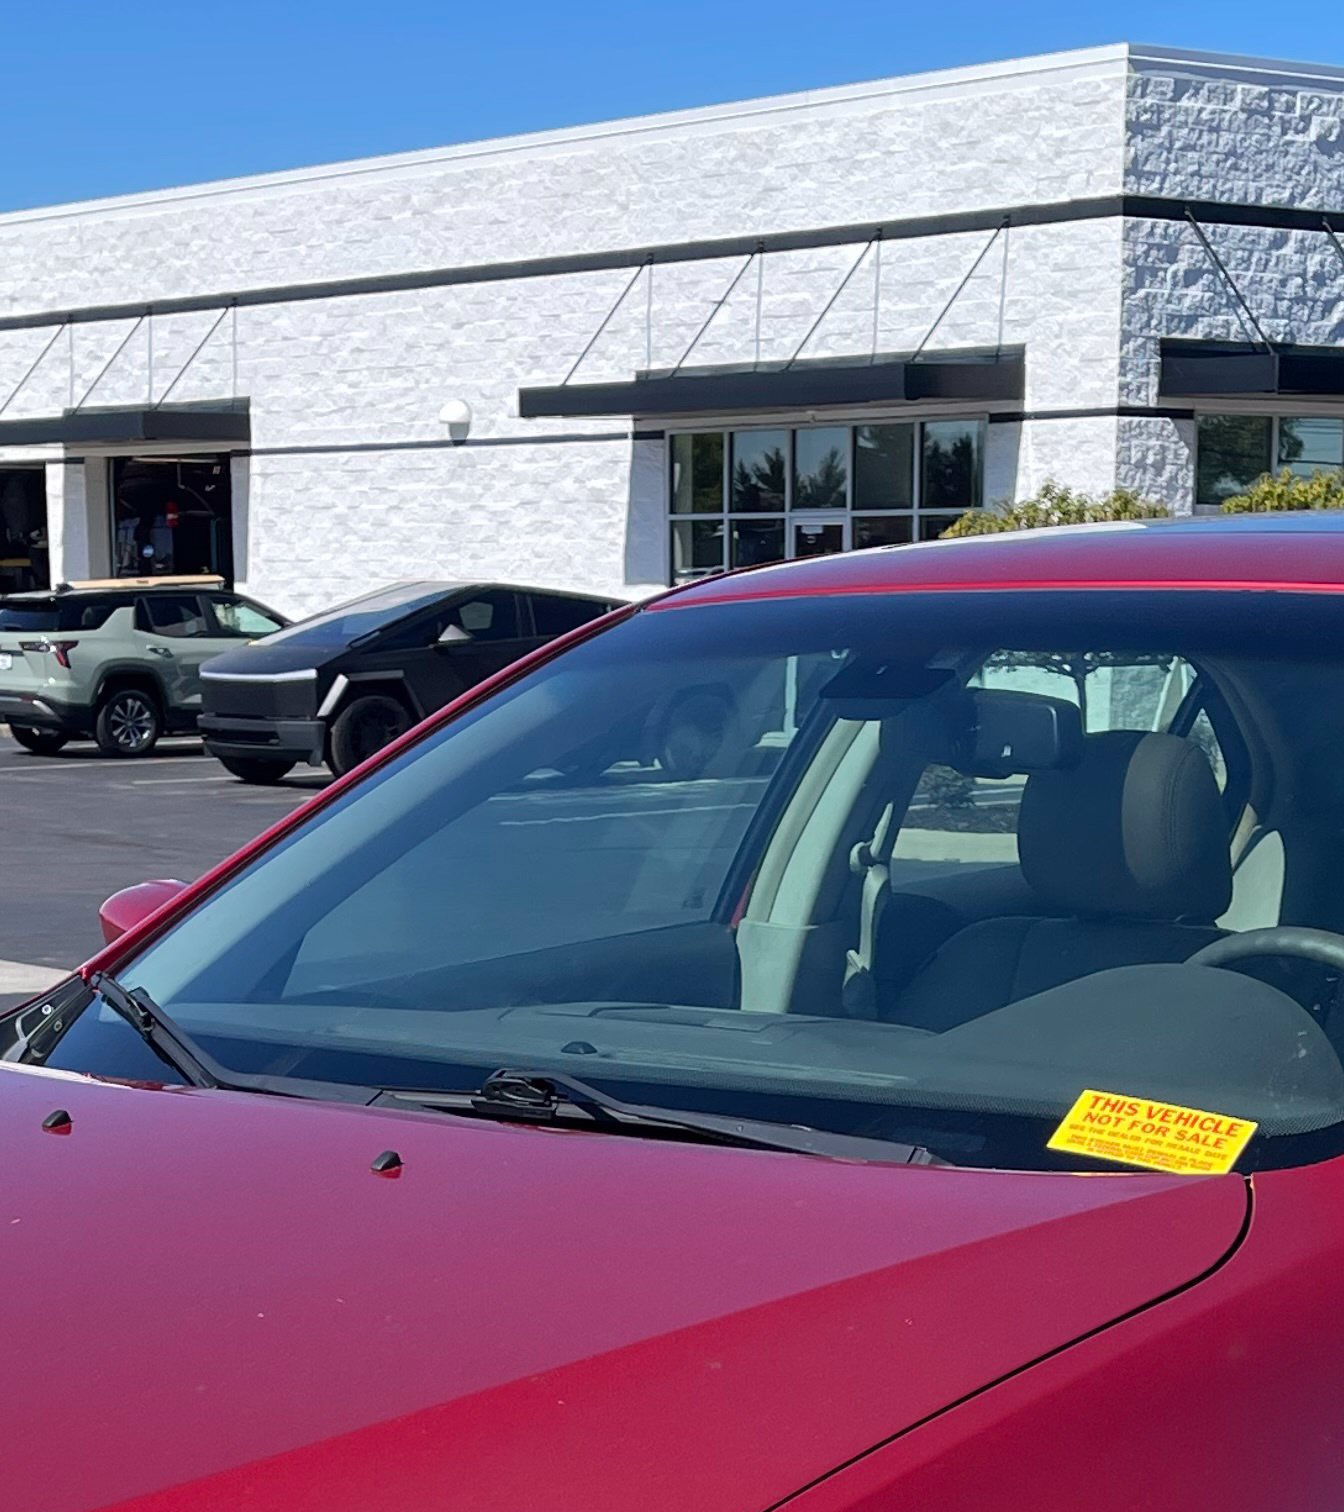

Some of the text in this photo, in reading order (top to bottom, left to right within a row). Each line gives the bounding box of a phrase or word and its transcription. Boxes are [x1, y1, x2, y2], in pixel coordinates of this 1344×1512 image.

[1083, 1111, 1228, 1149] NOT FOR SALE
[1090, 1095, 1244, 1137] THIS VEHICLE
